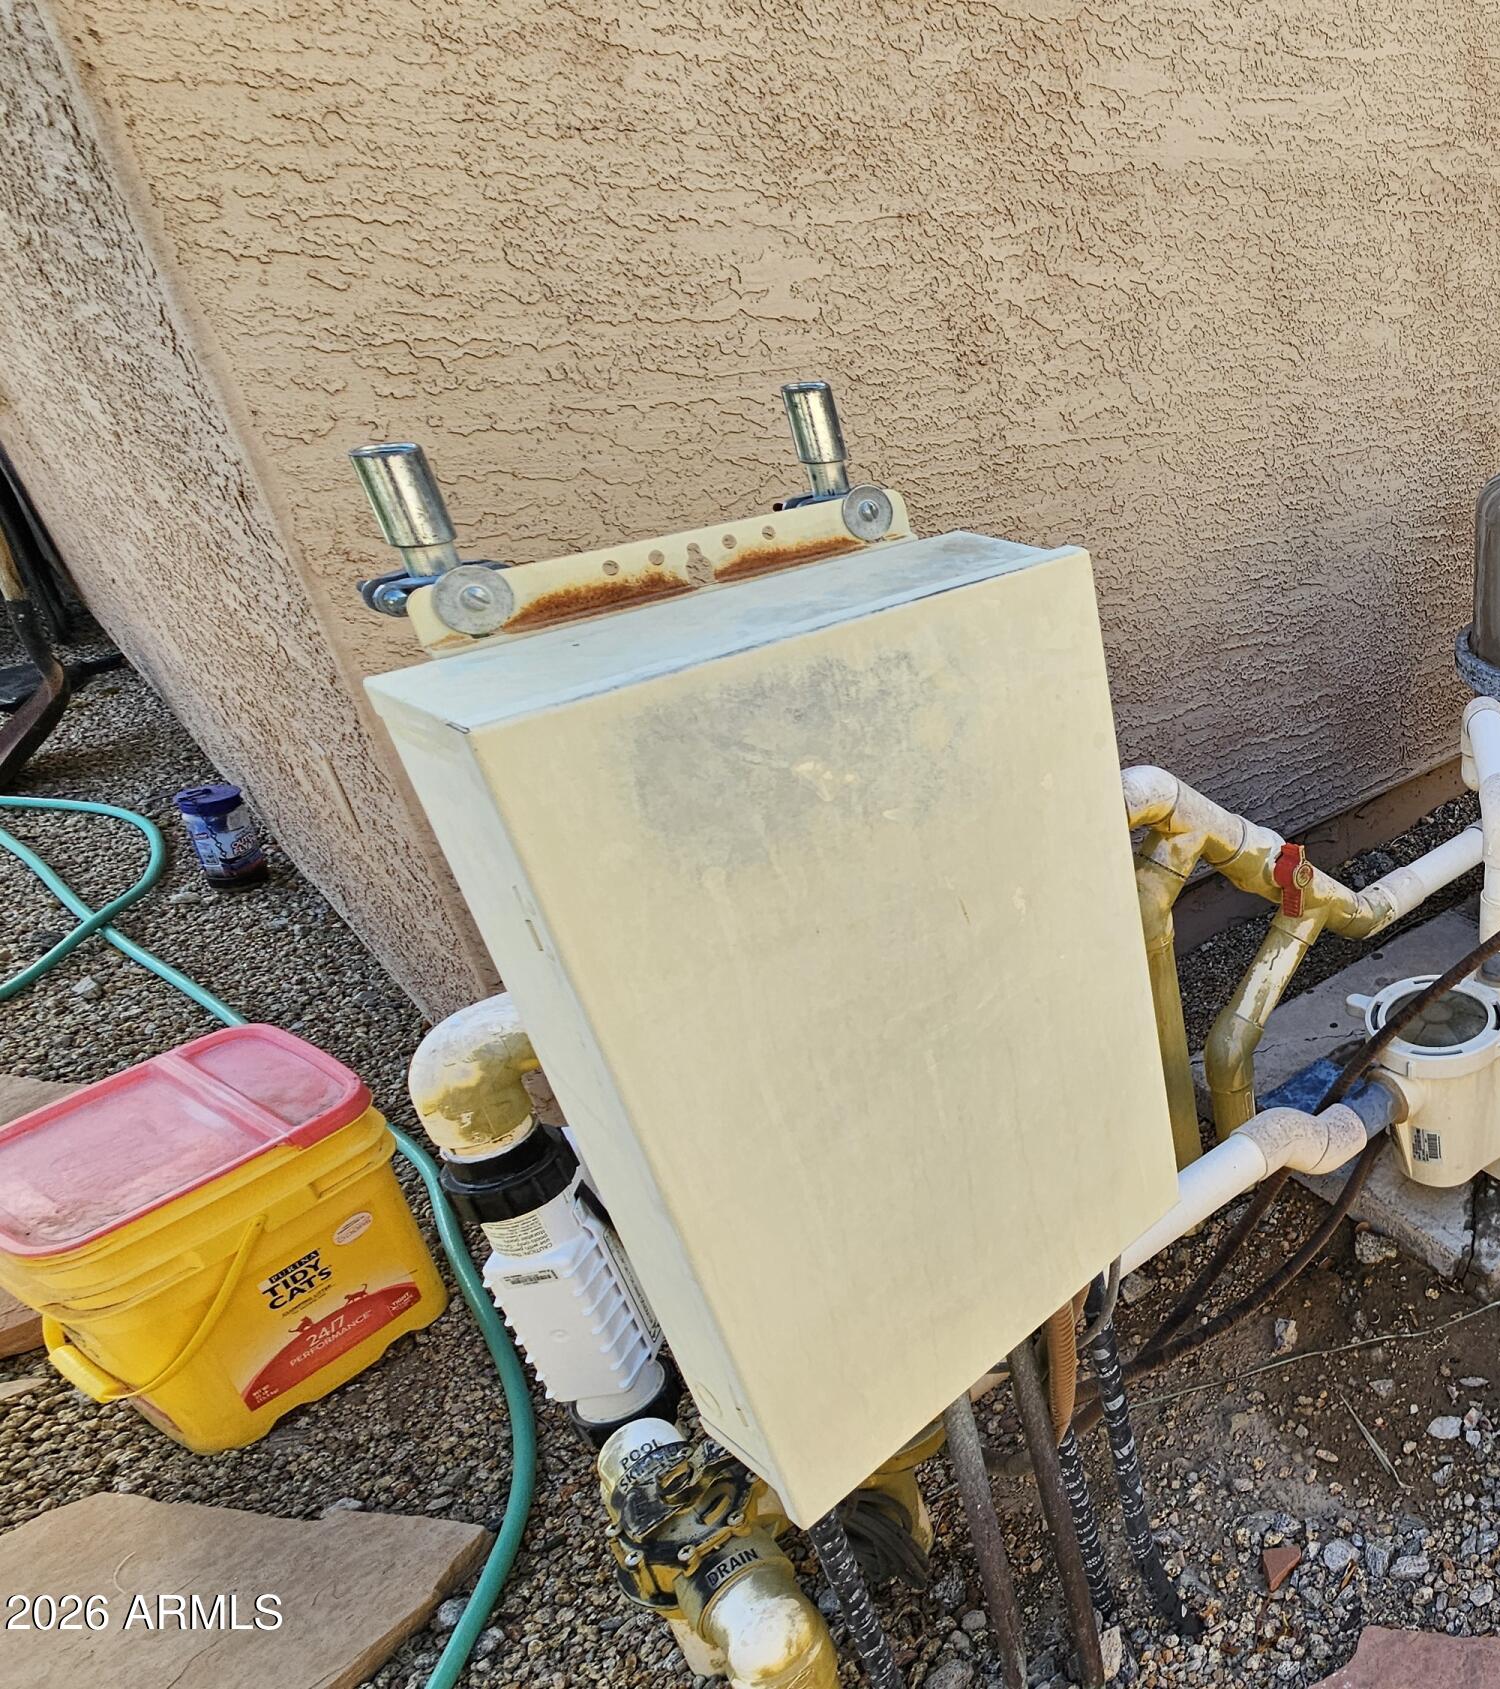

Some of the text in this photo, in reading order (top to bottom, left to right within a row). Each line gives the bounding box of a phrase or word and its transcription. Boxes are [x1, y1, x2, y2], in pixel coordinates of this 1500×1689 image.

[262, 1258, 320, 1297] TIDY
[270, 1252, 318, 1282] PURINA
[269, 1266, 332, 1310] CATS
[289, 1311, 369, 1368] PERFORMANCE
[306, 1315, 345, 1347] 24/7
[620, 1438, 661, 1471] POOL
[706, 1548, 760, 1587] DRAIN
